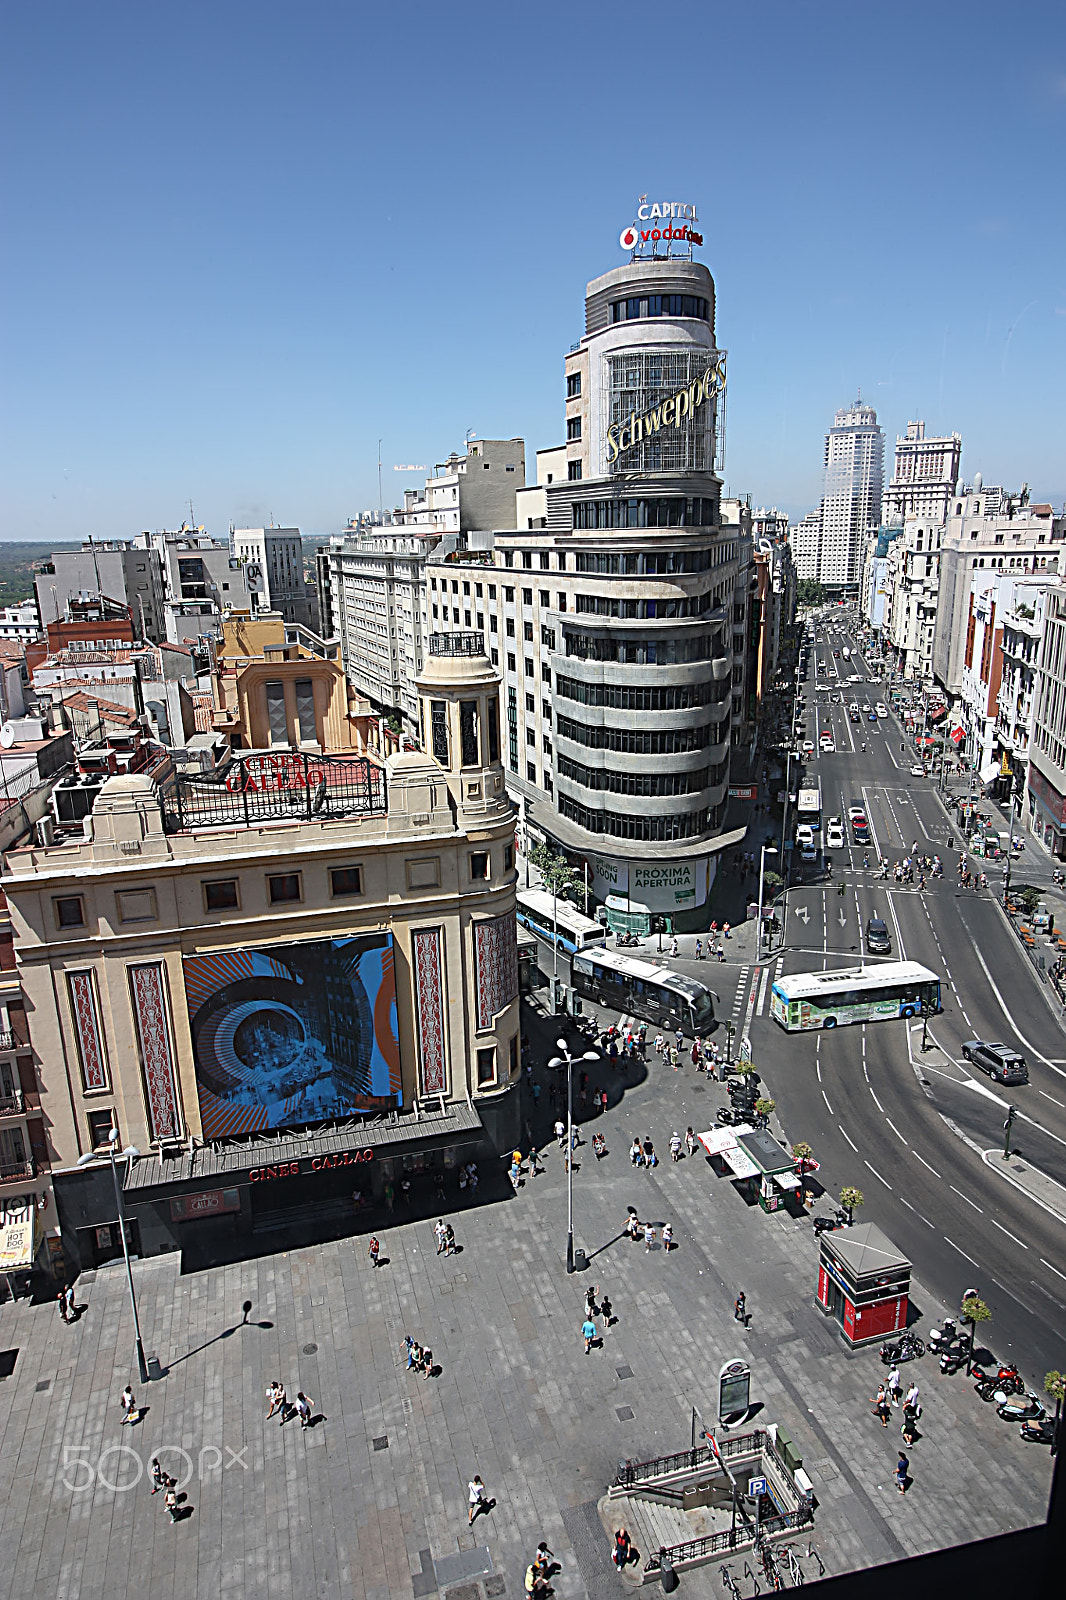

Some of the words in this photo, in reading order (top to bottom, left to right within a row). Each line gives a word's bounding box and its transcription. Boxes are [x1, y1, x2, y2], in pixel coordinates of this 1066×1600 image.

[638, 202, 698, 222] CAPITOL
[606, 358, 727, 463] Schweppes
[752, 602, 760, 647] HOTEL
[245, 753, 303, 770] CINES
[225, 769, 324, 793] CALLAO
[596, 865, 618, 883] SOON
[635, 866, 691, 879] PRÓXIMA
[635, 876, 691, 888] APERTURA
[249, 1162, 299, 1182] CINES
[311, 1149, 374, 1171] CALLAO
[7, 1233, 24, 1241] HOT
[753, 1481, 762, 1493] P
